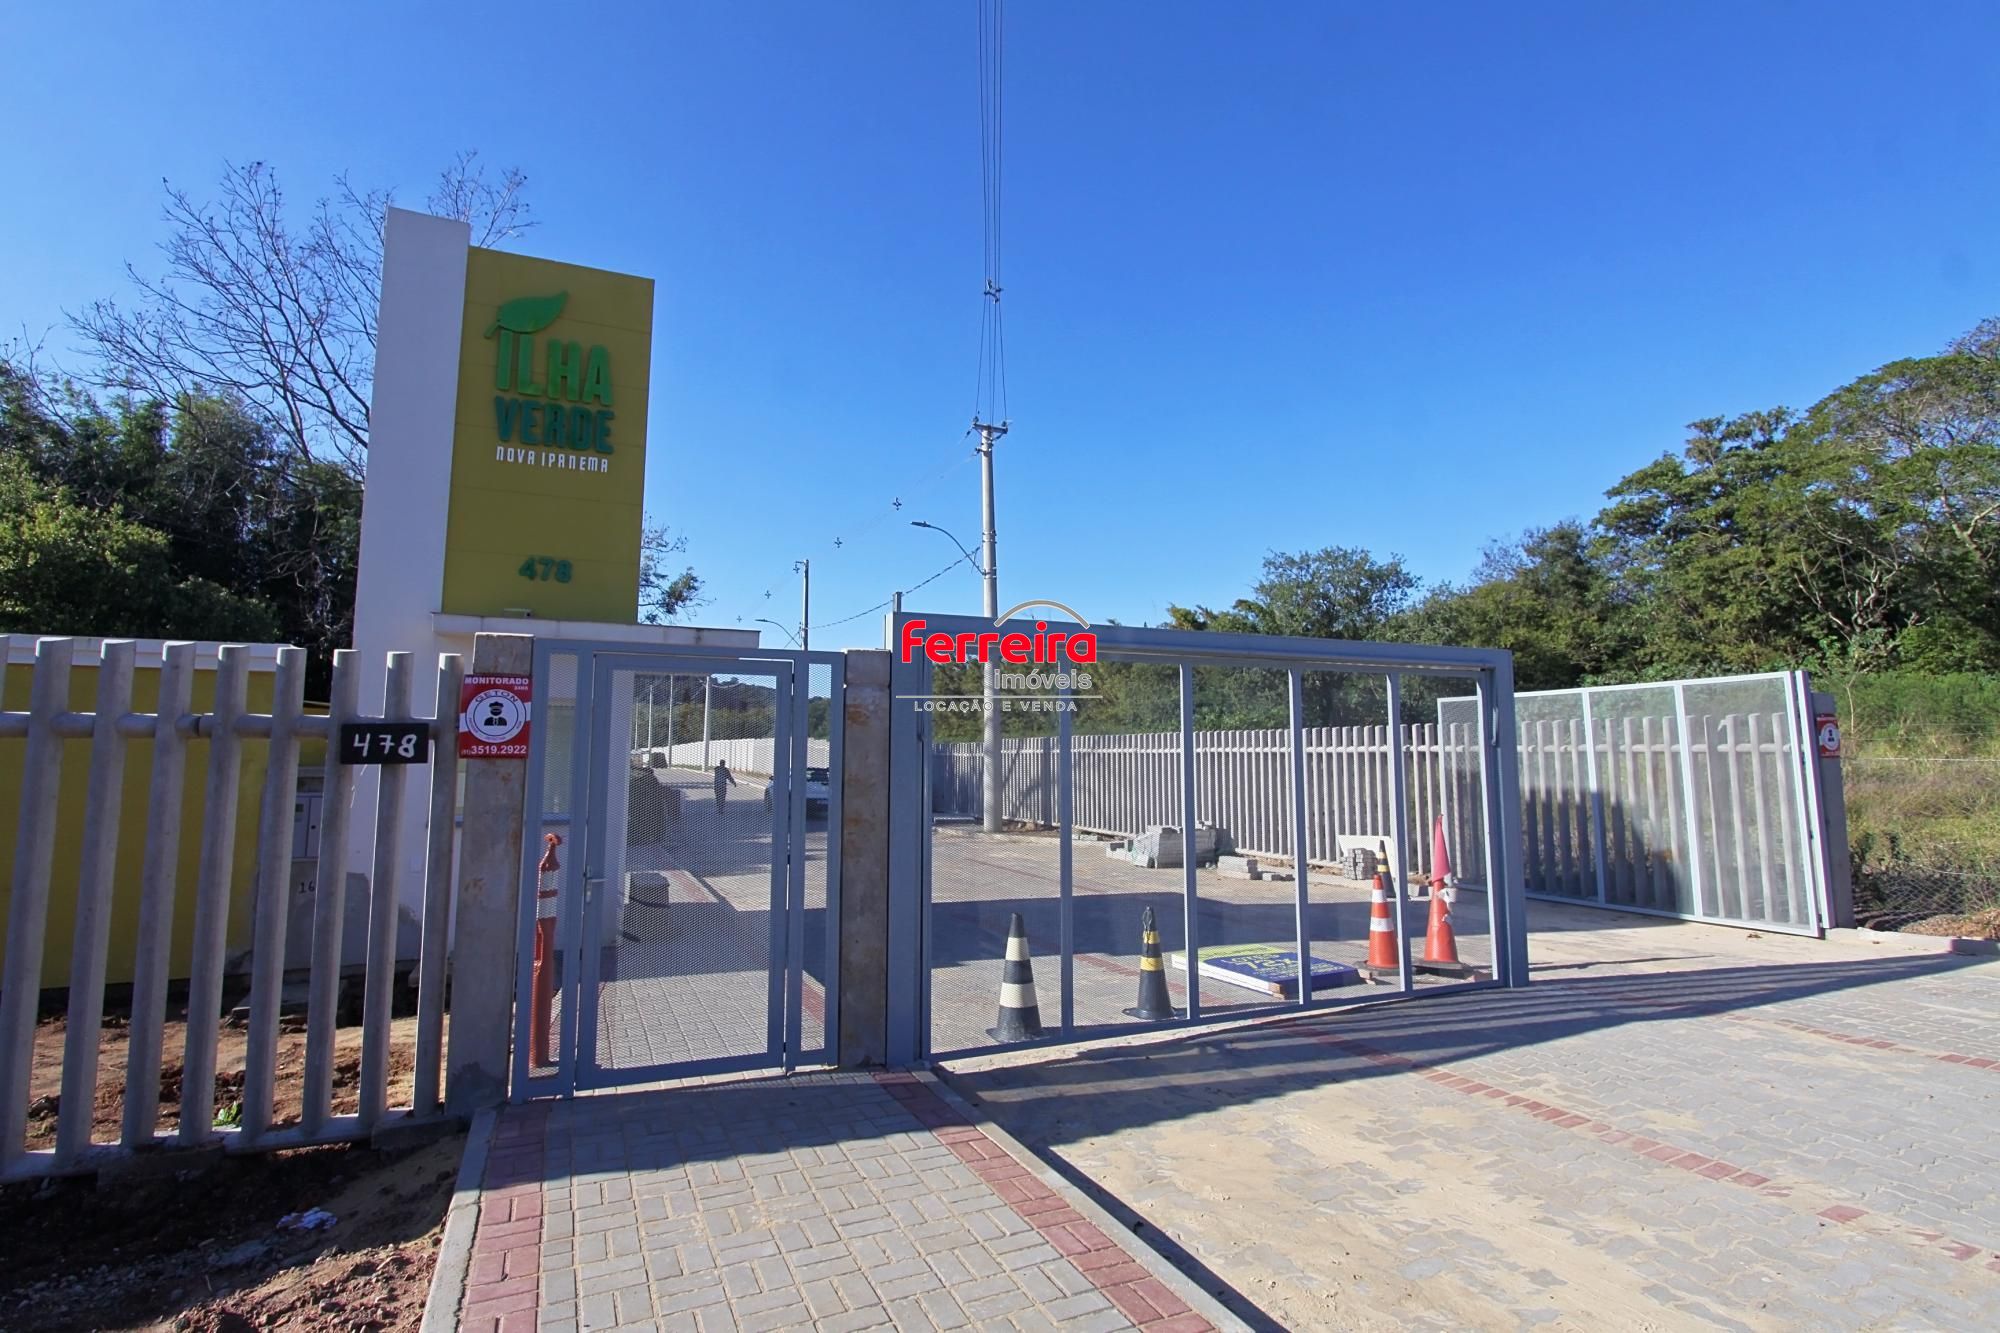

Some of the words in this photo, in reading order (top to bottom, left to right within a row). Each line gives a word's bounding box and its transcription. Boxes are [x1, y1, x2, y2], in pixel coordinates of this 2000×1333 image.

[496, 329, 613, 406] ILHA
[494, 396, 614, 454] VERDE
[496, 446, 535, 465] NOVA
[541, 452, 608, 473] IPANEMA
[518, 556, 572, 583] 478
[464, 677, 529, 685] MONITORADO
[353, 733, 418, 758] 478
[471, 745, 527, 755] 3519.2922
